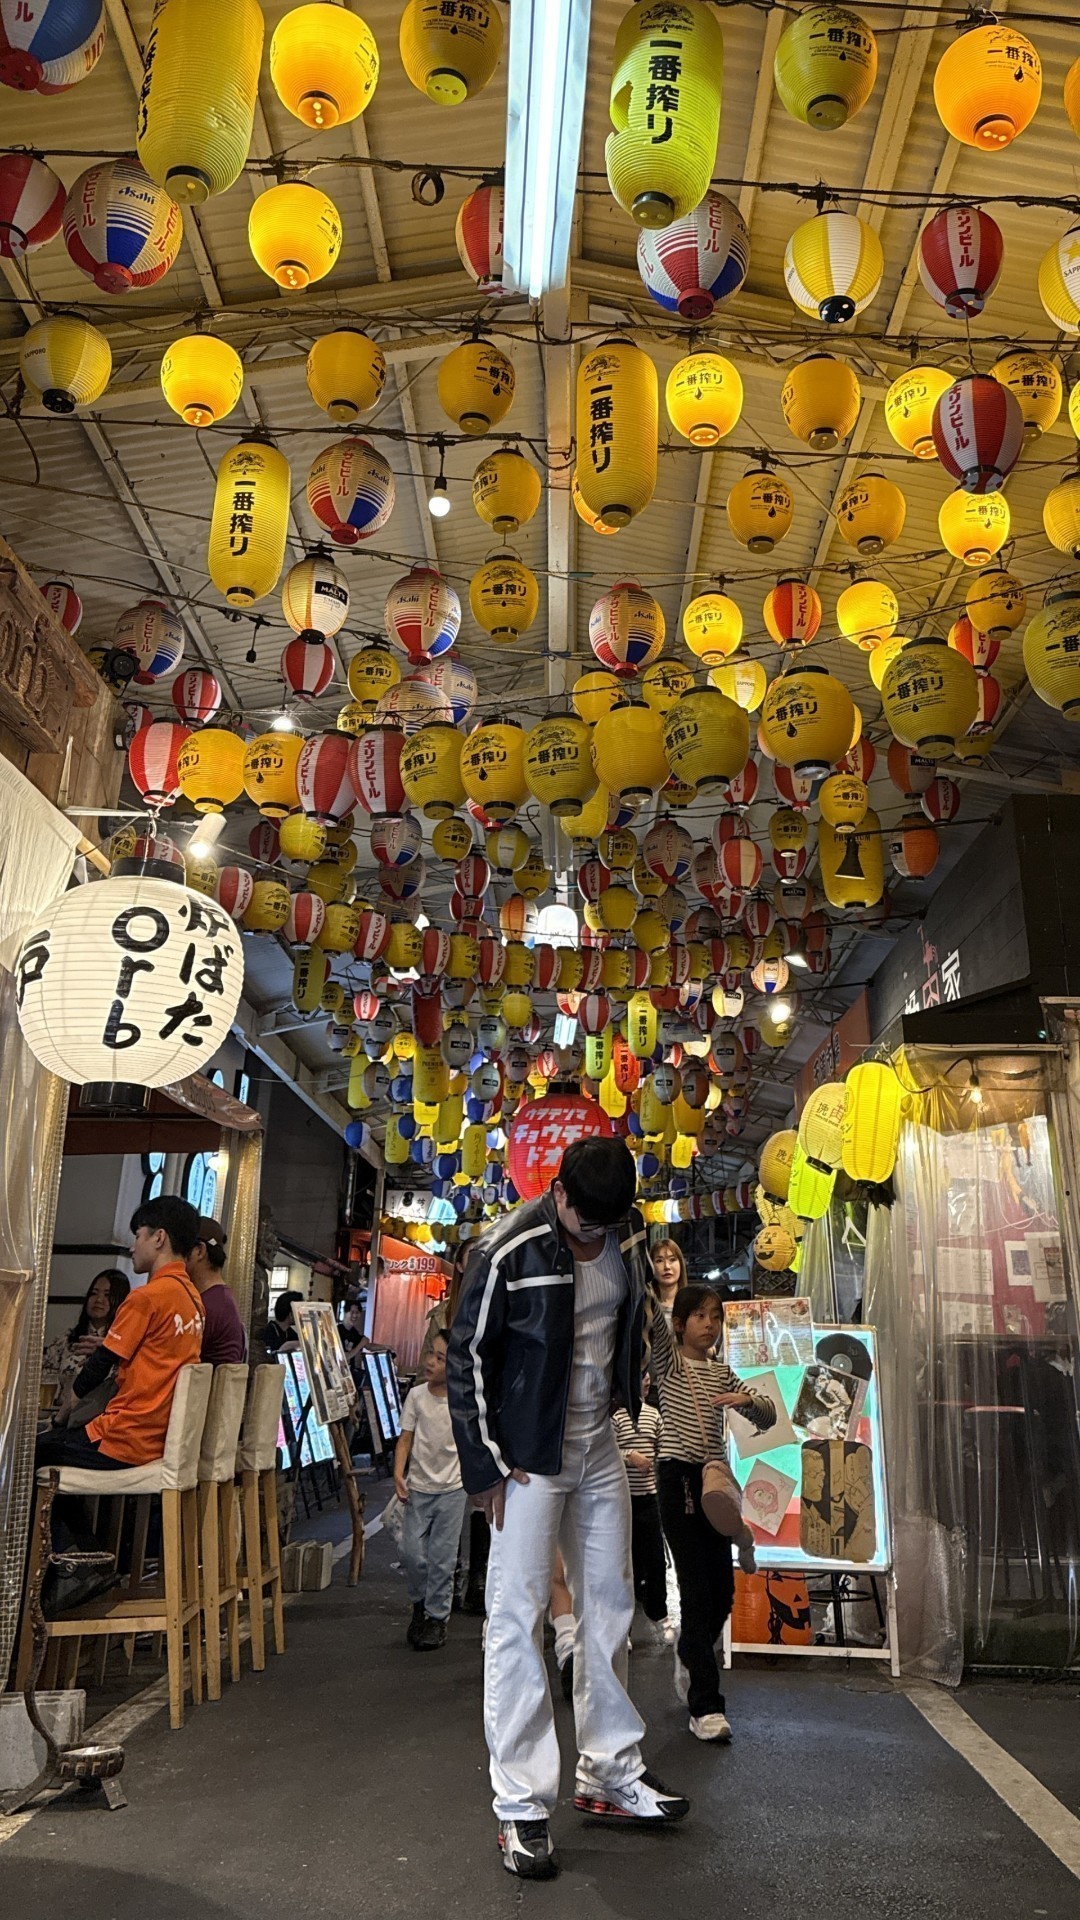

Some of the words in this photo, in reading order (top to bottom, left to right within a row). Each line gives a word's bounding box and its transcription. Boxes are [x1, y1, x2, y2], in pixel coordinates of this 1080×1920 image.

[422, 1, 490, 28] 一番搾り
[809, 28, 871, 54] 一番搾り
[645, 40, 683, 144] 一番搾り
[118, 186, 156, 205] Asahi
[955, 208, 974, 268] キリンビール
[23, 347, 47, 360] SAPPORO
[675, 372, 723, 388] 一番搾り
[1007, 375, 1057, 390] 一番搾り
[887, 386, 928, 412] 一番搾り
[947, 384, 970, 450] キリンビール
[590, 384, 613, 474] 一番搾り
[367, 467, 391, 486] Asahi
[751, 492, 792, 508] 一番搾り
[229, 480, 257, 557] 一番搾り
[965, 505, 1006, 520] 一番搾り
[481, 583, 527, 597] 一番搾り
[397, 595, 420, 605] Asahi
[796, 585, 808, 628] キリンビール
[609, 593, 620, 642] アサヒビール
[634, 610, 655, 621] Asahi
[688, 612, 723, 625] 一番搾り
[357, 666, 392, 678] 一番搾り
[887, 676, 944, 700] 一番搾り
[766, 701, 819, 724] 一番搾り
[244, 757, 284, 770] 一番搾り
[400, 752, 438, 772] 一番搾り
[462, 750, 508, 767] 一番搾り
[528, 746, 580, 765] 一番搾り
[301, 739, 319, 796] キリンビール
[364, 739, 382, 799] キリンビール
[833, 792, 865, 803] 一番搾り
[777, 825, 803, 833] 一番搾り
[102, 906, 170, 1050] Orb
[639, 1008, 648, 1047] 一番搾り
[416, 1257, 436, 1270] 199
